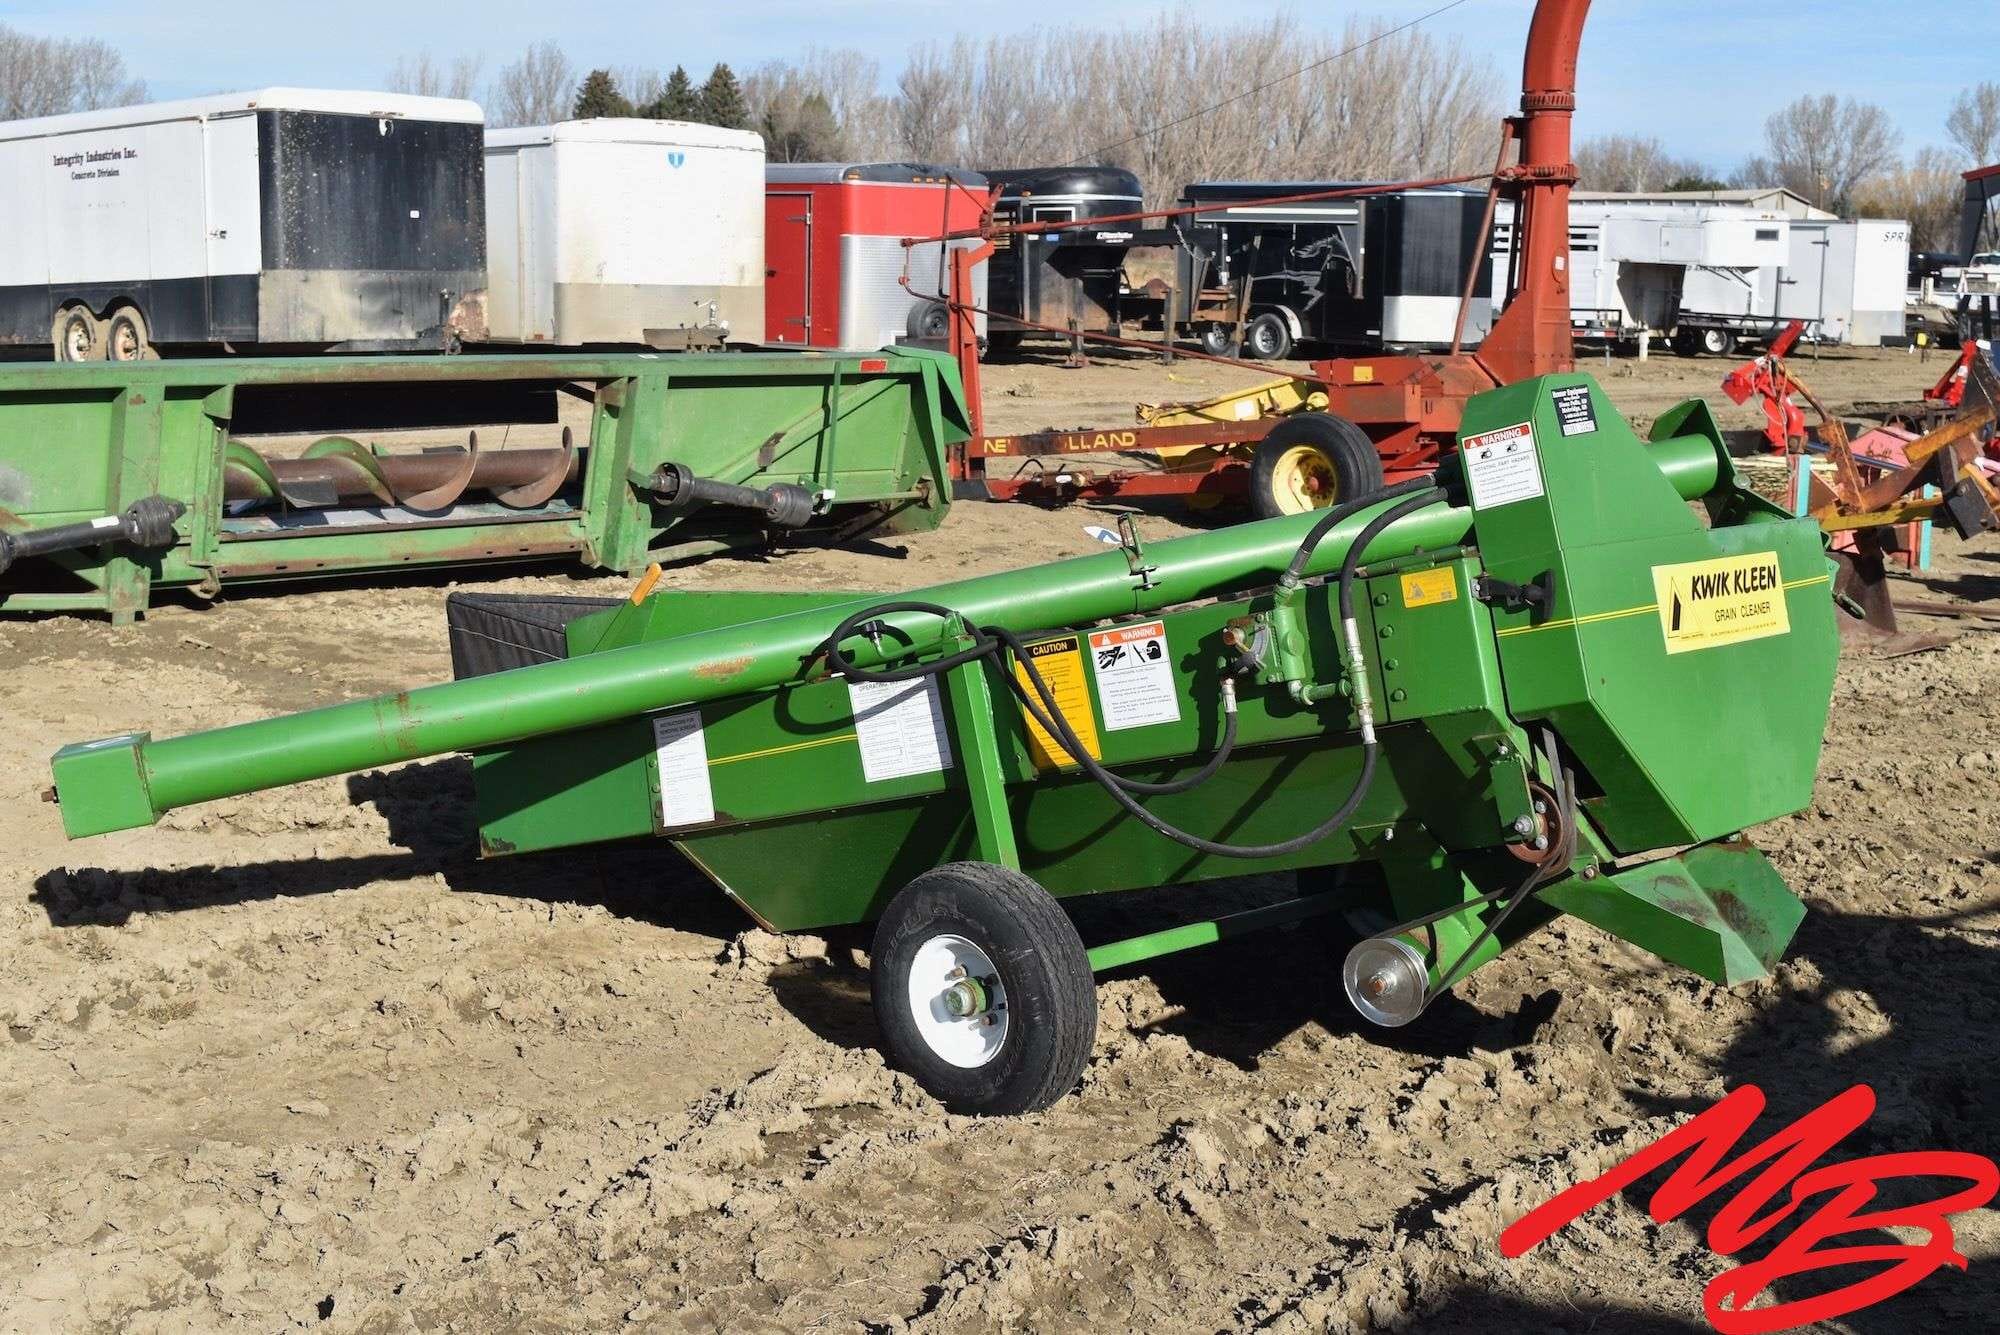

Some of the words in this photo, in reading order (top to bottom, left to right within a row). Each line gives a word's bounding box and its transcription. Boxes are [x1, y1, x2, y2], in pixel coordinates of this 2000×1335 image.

[53, 153, 84, 168] Integrity
[86, 148, 122, 163] Industries
[124, 147, 138, 160] Inc.
[71, 171, 96, 181] Concrete
[97, 168, 120, 178] Division
[1479, 427, 1522, 446] WARNING
[1691, 571, 1731, 601] KWIK
[1734, 564, 1776, 594] KLEEN
[1714, 607, 1738, 623] GRAIN
[1740, 601, 1772, 618] CLEANER
[1120, 626, 1156, 640] WARNING
[1032, 642, 1068, 656] CAUTION
